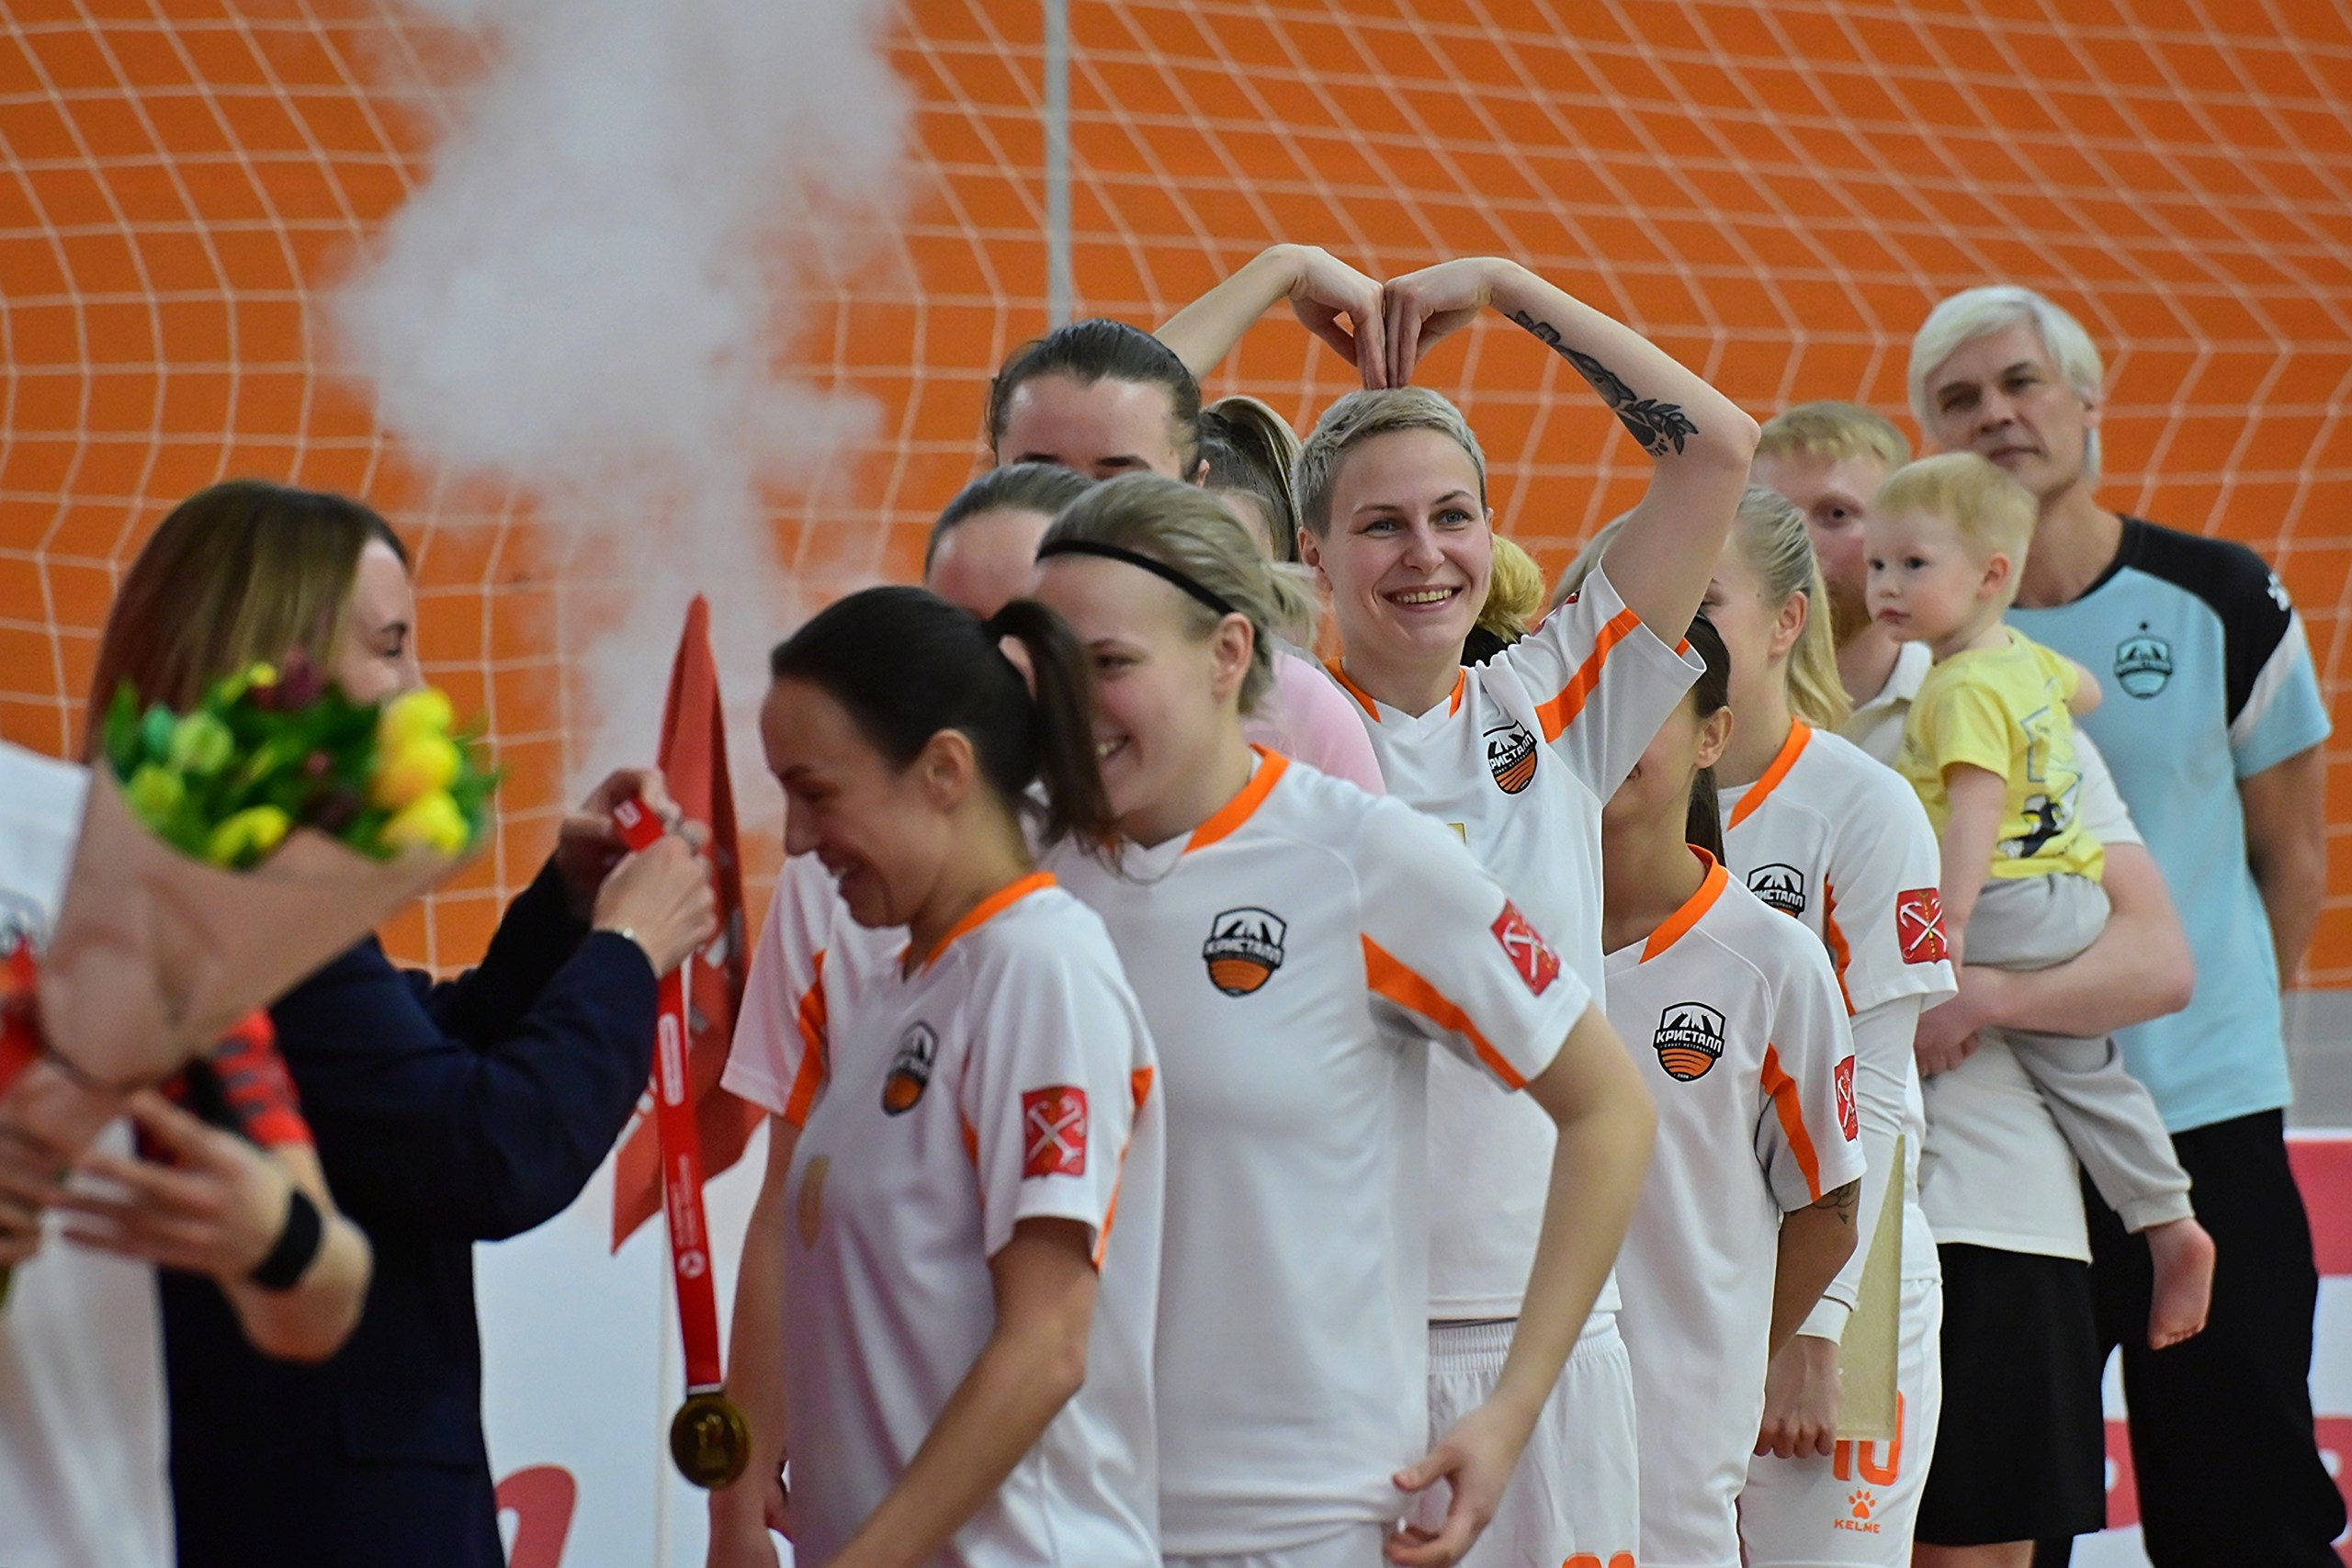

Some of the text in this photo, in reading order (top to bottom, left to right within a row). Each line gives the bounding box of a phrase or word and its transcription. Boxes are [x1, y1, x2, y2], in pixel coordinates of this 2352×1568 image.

[1488, 733, 1534, 770] РИСТАЛЛ
[1656, 1029, 1723, 1054] КРИСТАЛЛ
[1833, 1517, 1881, 1535] KELME
